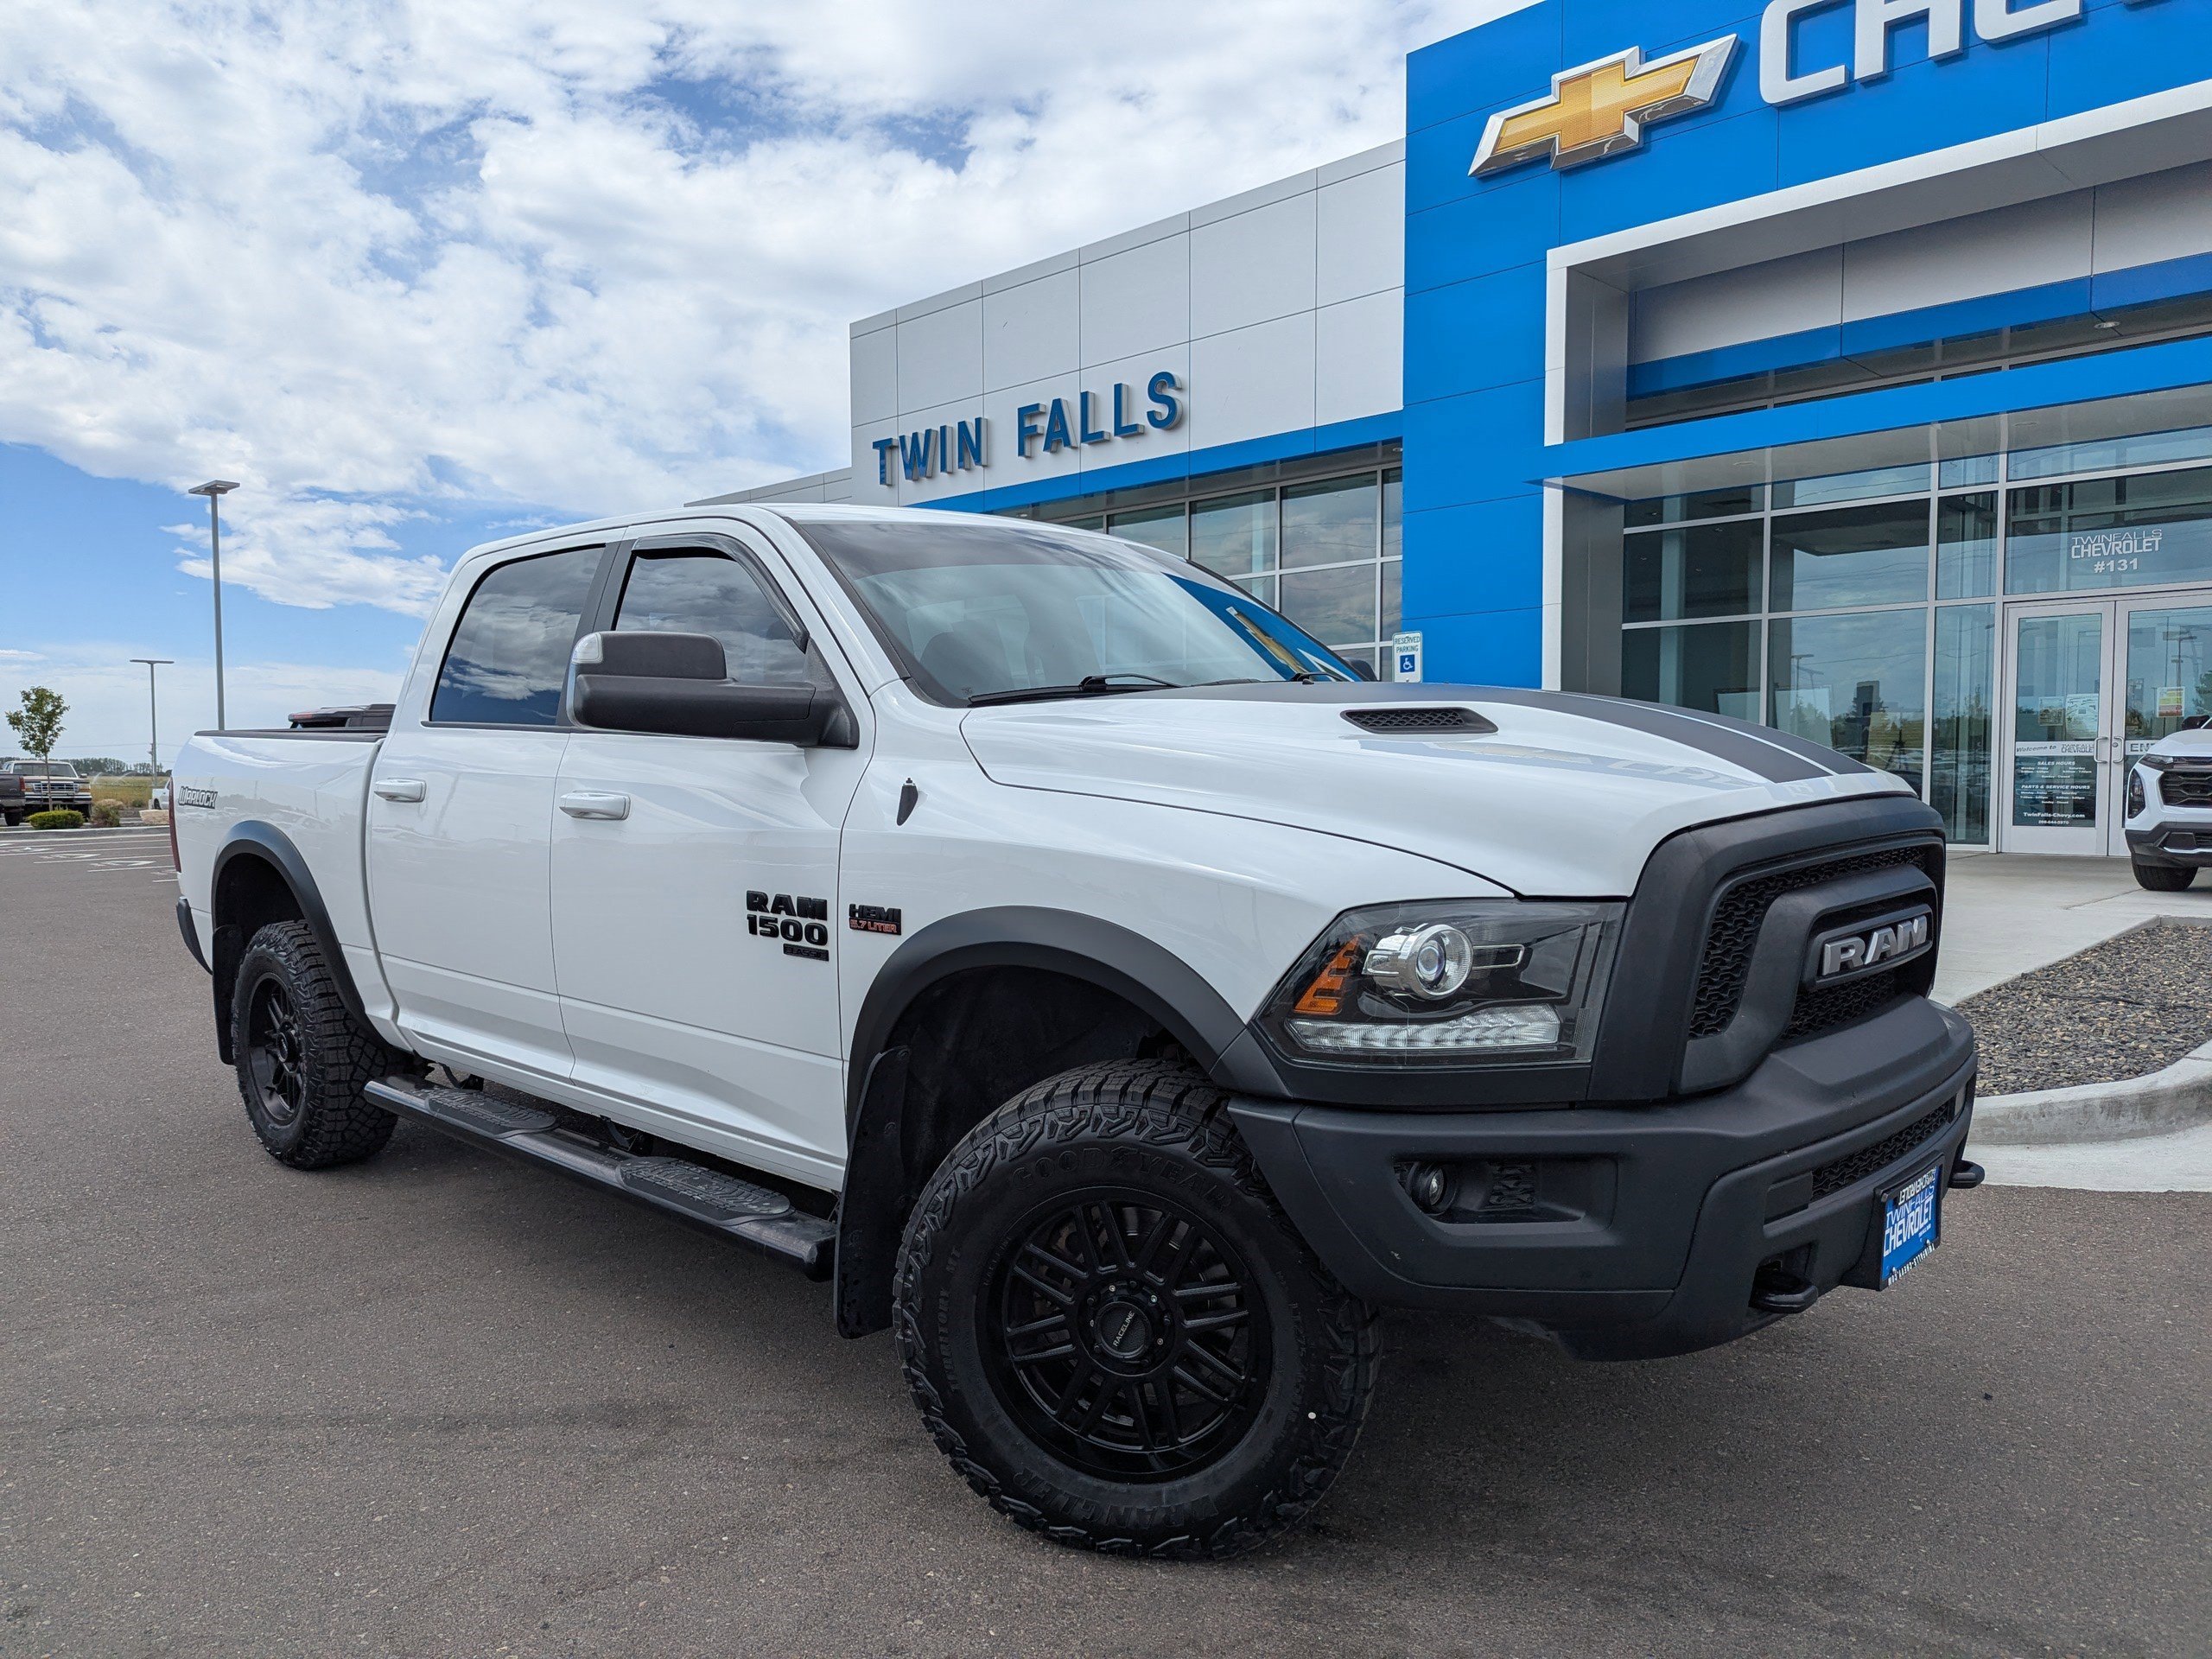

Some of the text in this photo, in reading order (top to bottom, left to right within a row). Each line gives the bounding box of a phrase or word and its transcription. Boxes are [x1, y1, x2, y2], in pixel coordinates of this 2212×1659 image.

[872, 371, 1183, 486] TWIN FALLS
[2071, 529, 2163, 545] TWINFALLS
[2071, 537, 2163, 559] CHEVROLET
[2094, 557, 2138, 574] #131
[1395, 635, 1421, 645] RESERVED
[1396, 645, 1419, 653] PARKING
[178, 786, 218, 809] WARLOCK
[747, 890, 828, 921] RAM
[849, 904, 901, 923] HEMI
[747, 914, 828, 946] 1500
[849, 918, 898, 933] 5.7 LITER
[1822, 915, 1928, 976] RAM
[1012, 1147, 1232, 1213] GOODYEAR
[1886, 1183, 1935, 1228] TWINFALLS
[1884, 1194, 1934, 1257] CHEVROLET
[1113, 1310, 1135, 1347] RACELINE
[1013, 1467, 1218, 1530] WRANGLER
